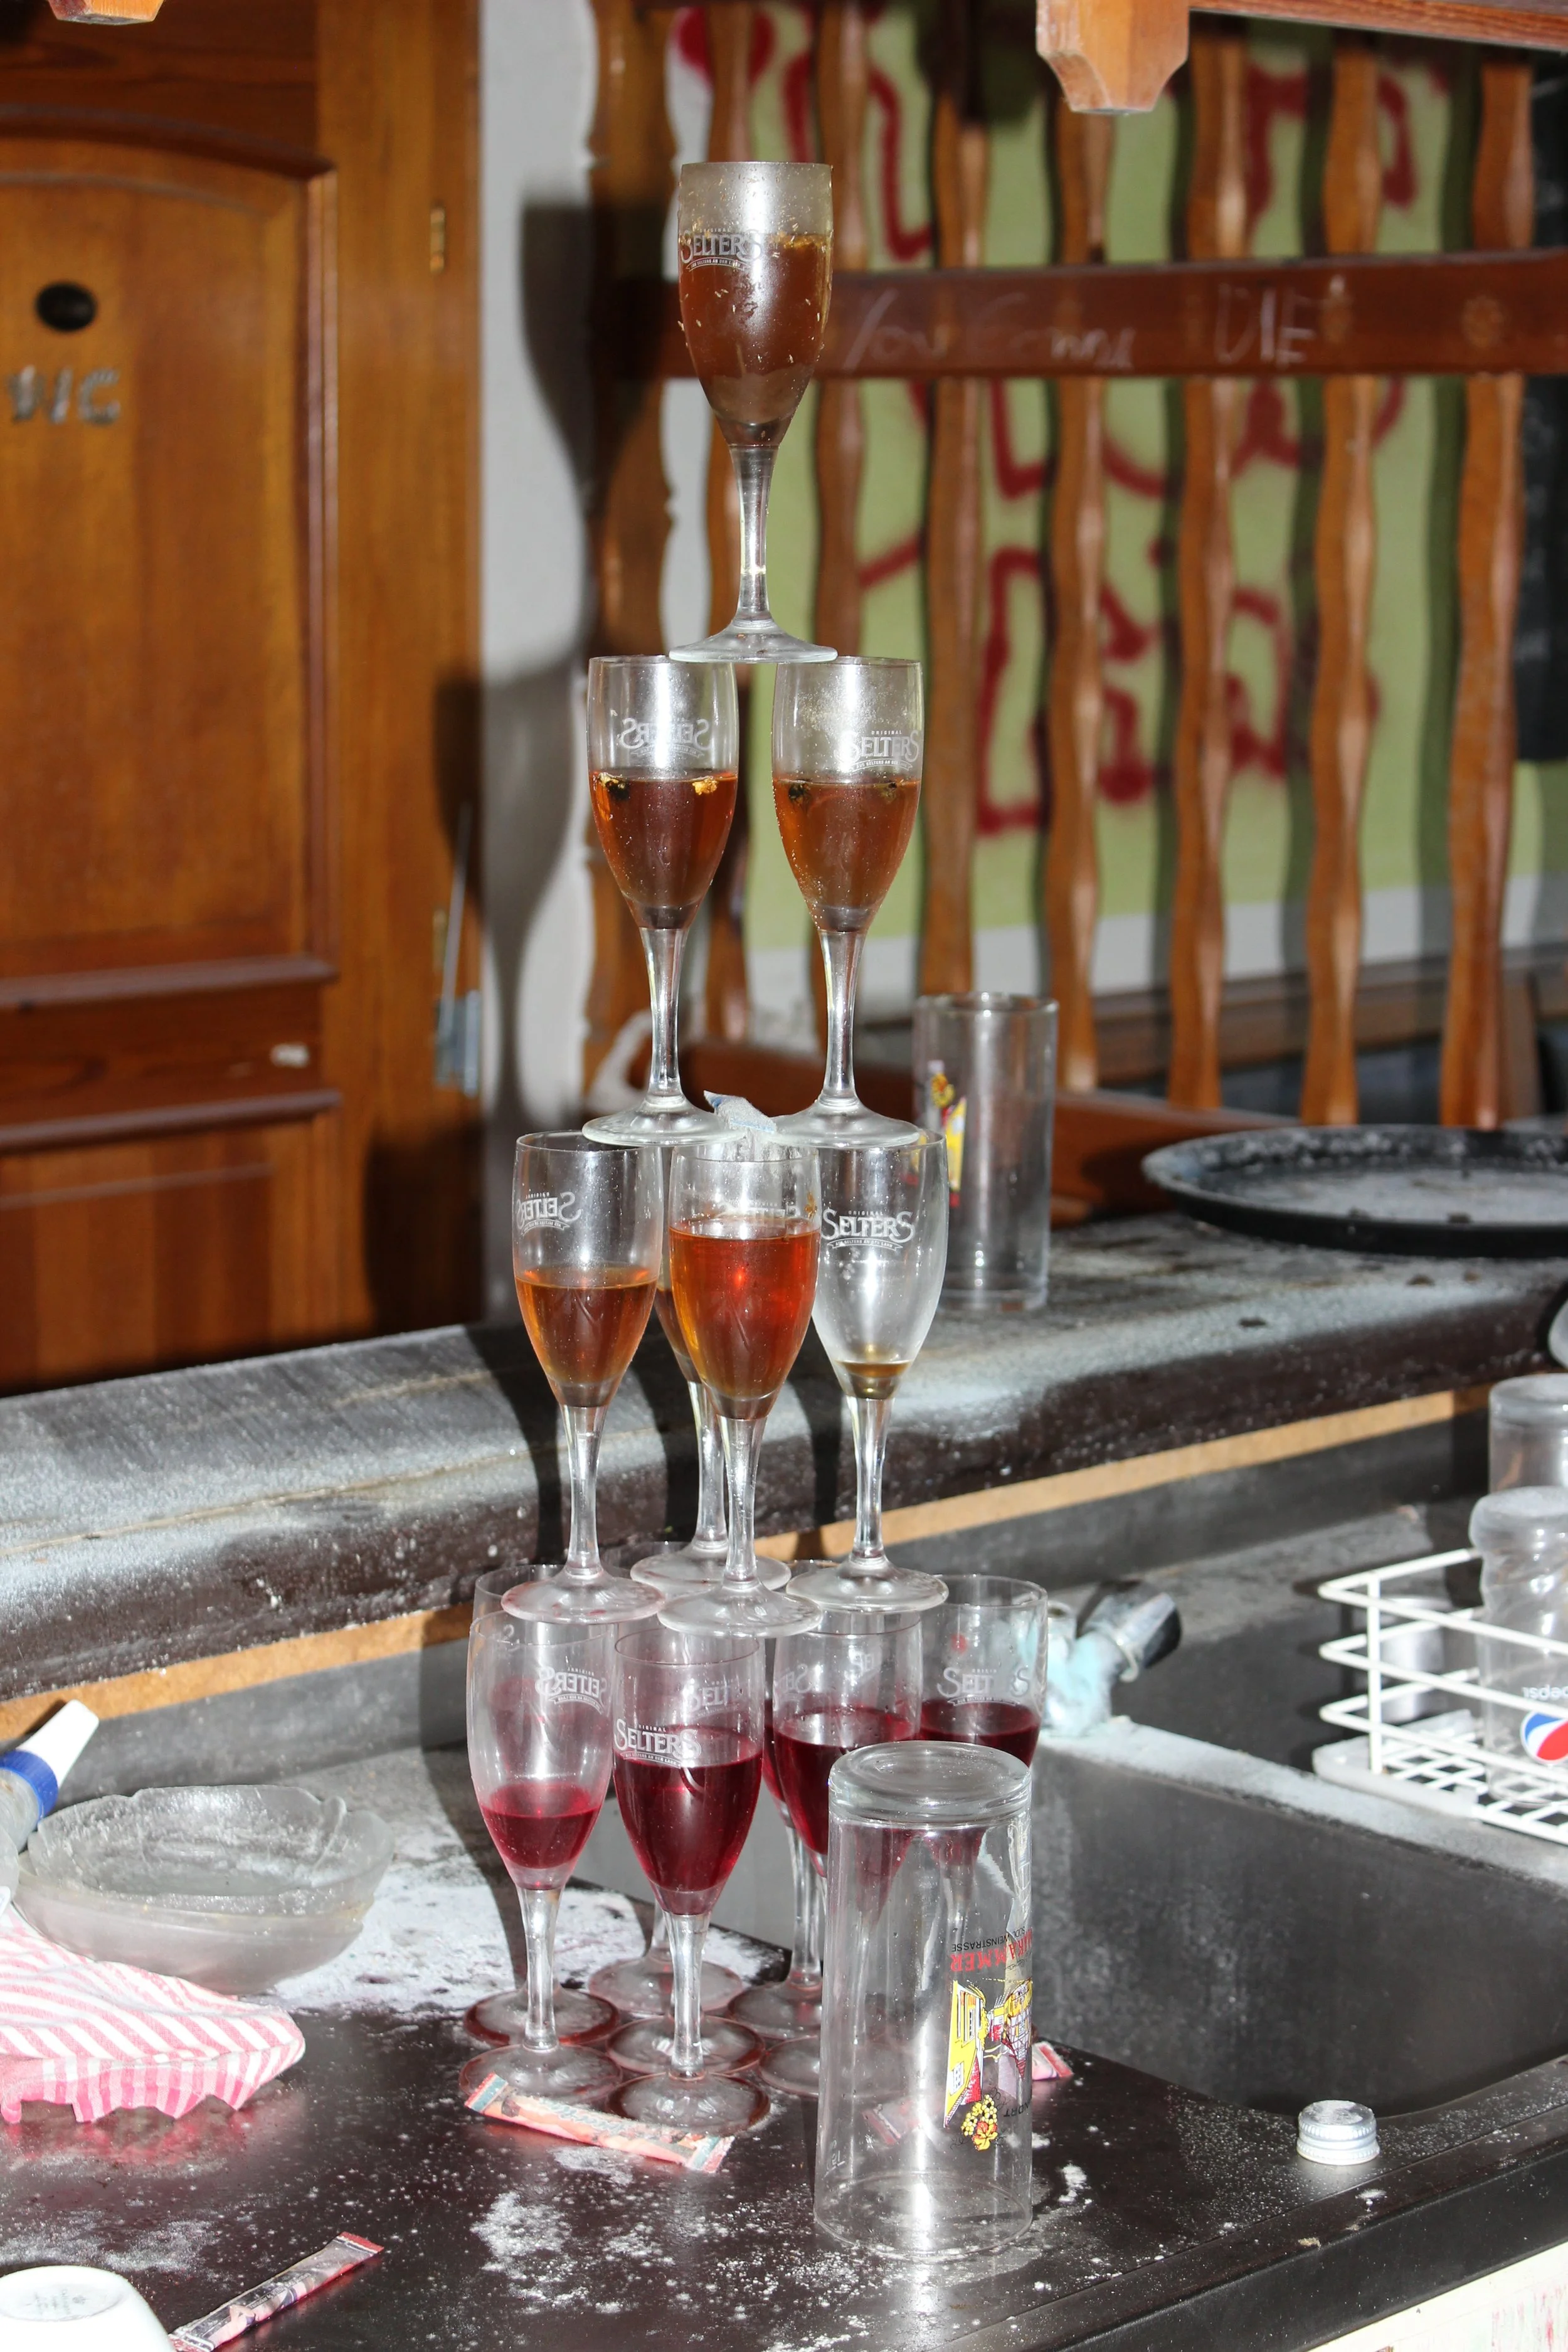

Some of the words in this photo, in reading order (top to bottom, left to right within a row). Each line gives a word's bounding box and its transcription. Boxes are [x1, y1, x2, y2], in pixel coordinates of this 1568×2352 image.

[681, 229, 763, 263] SELTERS
[6, 364, 121, 425] WC
[834, 729, 919, 764] SELTERS
[822, 1209, 916, 1243] SELTERS
[614, 1719, 701, 1759] SELTERS
[951, 1935, 1010, 1952] WEINSTRASSE
